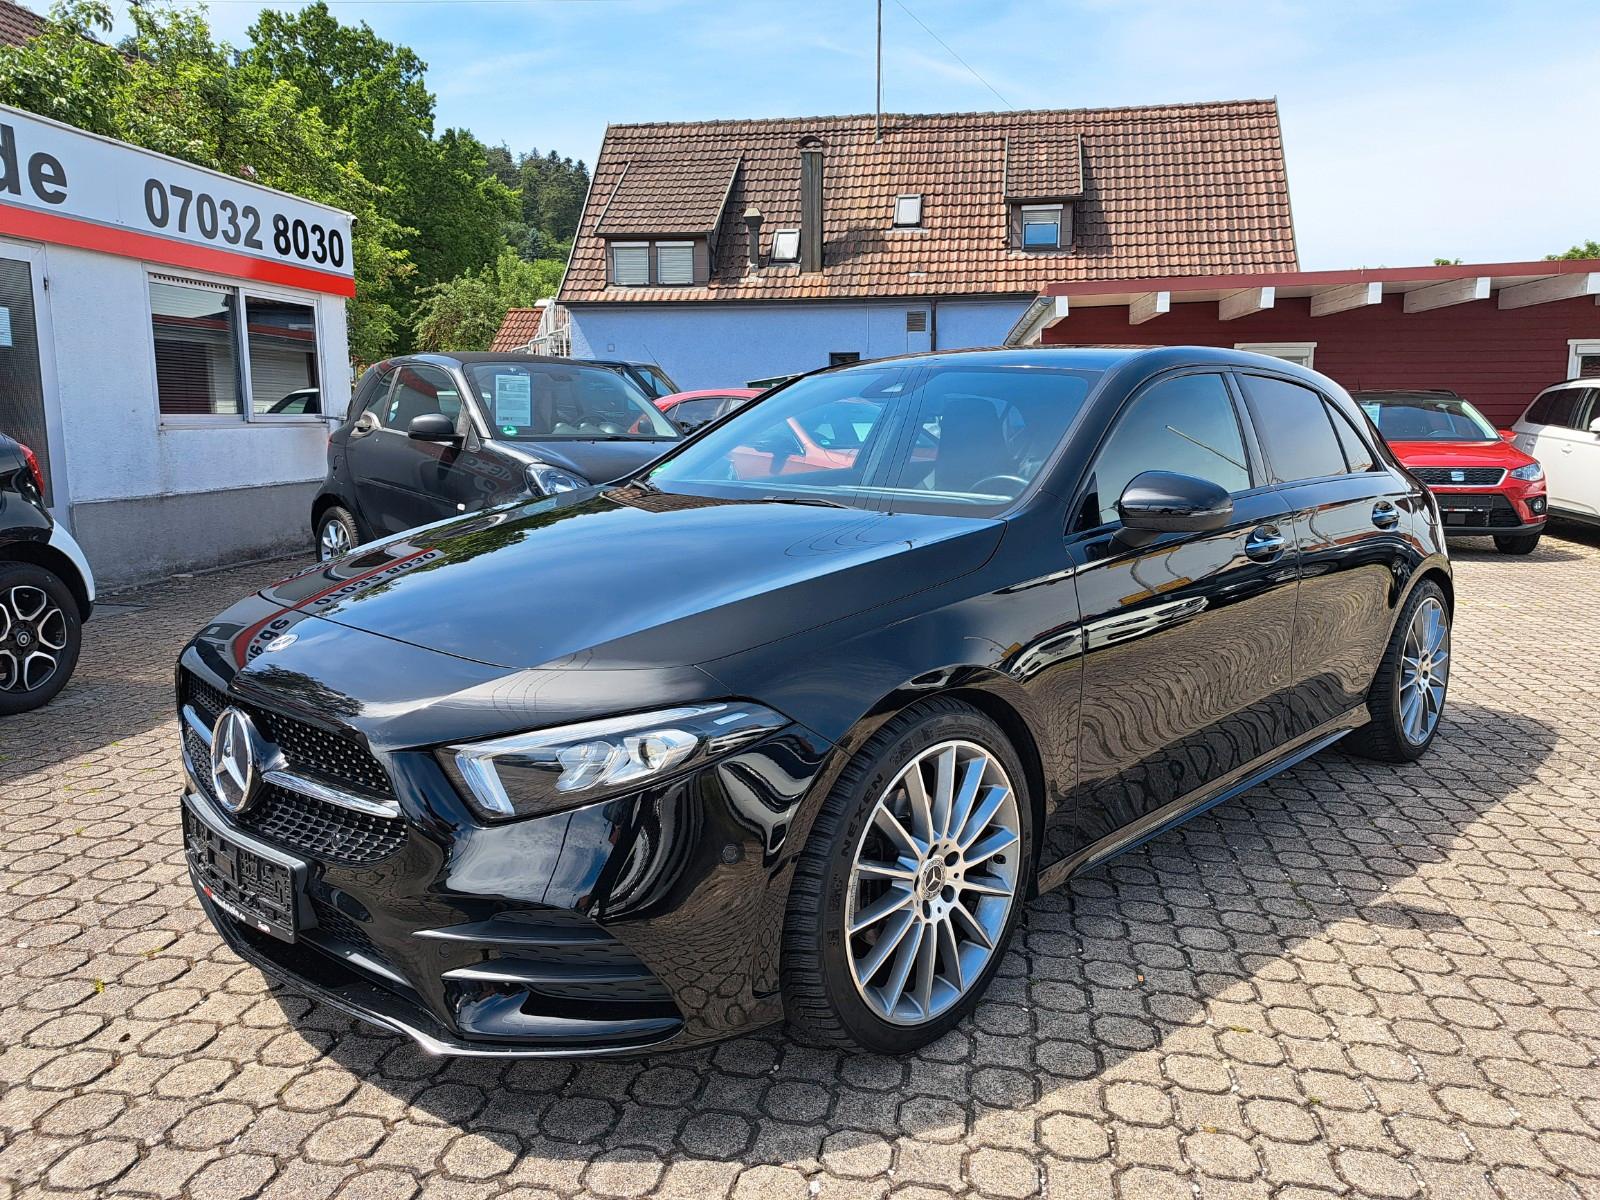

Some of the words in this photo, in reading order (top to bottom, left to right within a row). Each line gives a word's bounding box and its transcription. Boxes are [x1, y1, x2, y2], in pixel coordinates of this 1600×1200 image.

[144, 178, 263, 250] 07032
[273, 213, 344, 268] 8030
[841, 773, 884, 857] NEXEN
